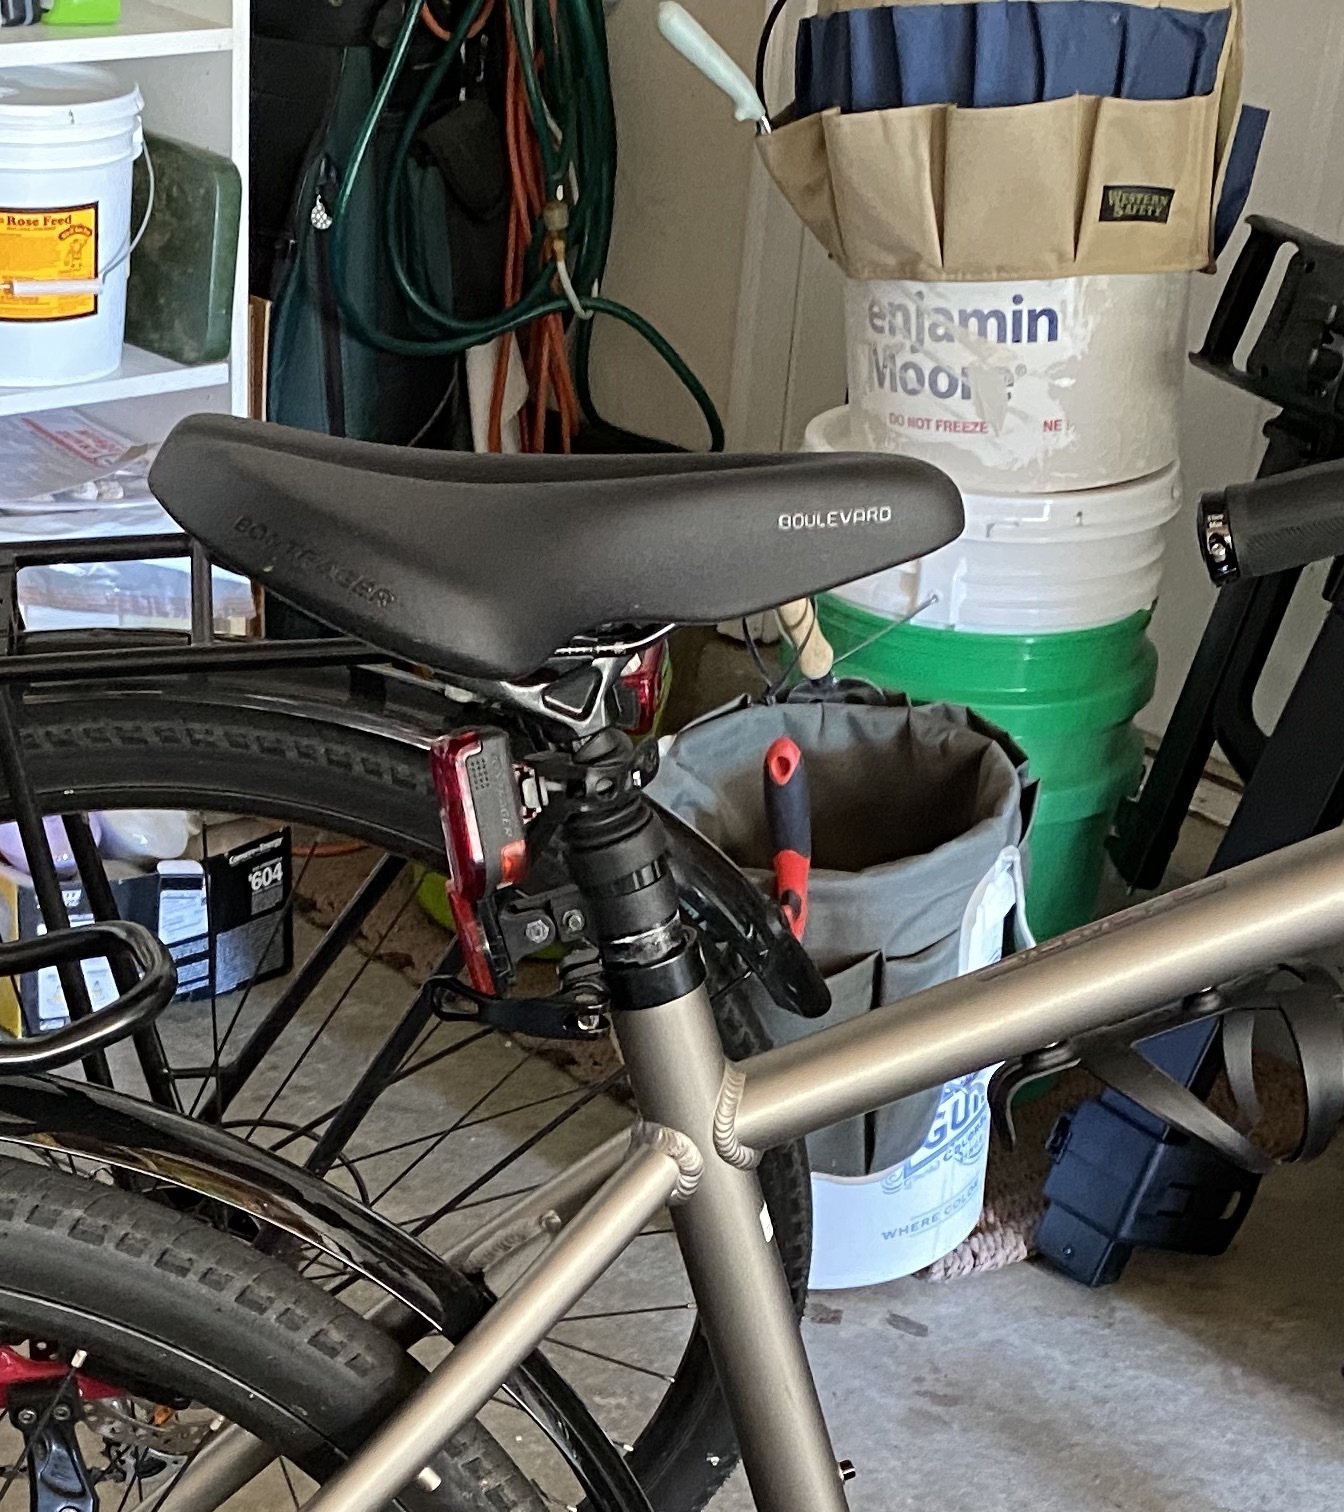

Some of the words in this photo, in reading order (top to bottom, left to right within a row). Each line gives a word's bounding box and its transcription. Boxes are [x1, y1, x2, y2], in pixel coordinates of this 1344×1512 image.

[6, 214, 40, 227] Rose
[43, 214, 73, 226] Feed
[867, 290, 1059, 354] enjamin
[888, 412, 906, 428] DO
[907, 416, 932, 430] NOT
[935, 418, 989, 434] FREEZE
[777, 505, 892, 530] BOULEVARD
